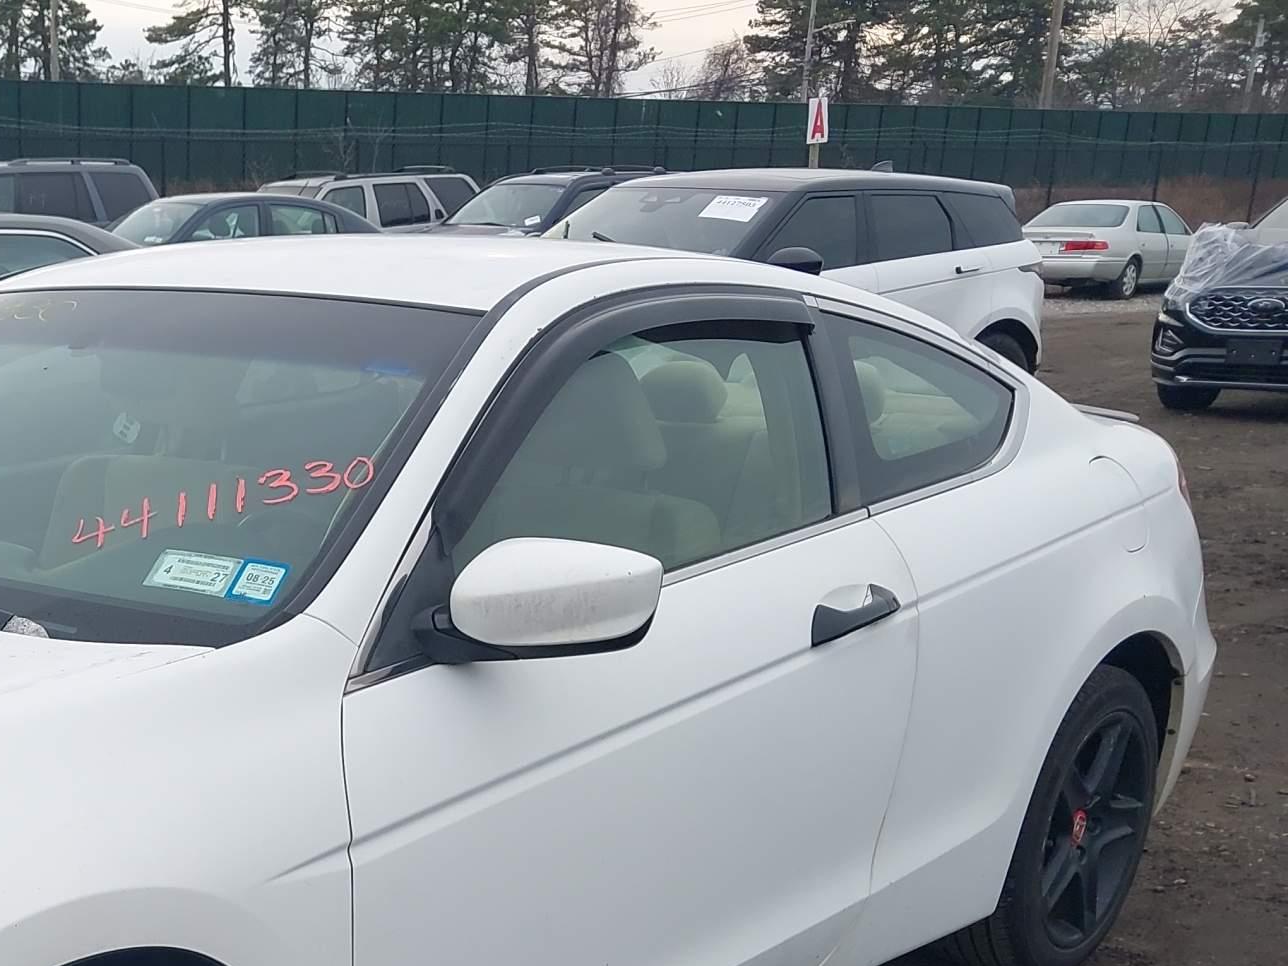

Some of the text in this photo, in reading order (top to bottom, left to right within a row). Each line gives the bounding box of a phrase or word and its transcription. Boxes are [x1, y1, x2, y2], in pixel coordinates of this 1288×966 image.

[811, 99, 825, 139] A
[72, 456, 374, 548] 44111330
[163, 564, 174, 575] 4
[211, 572, 230, 584] 27
